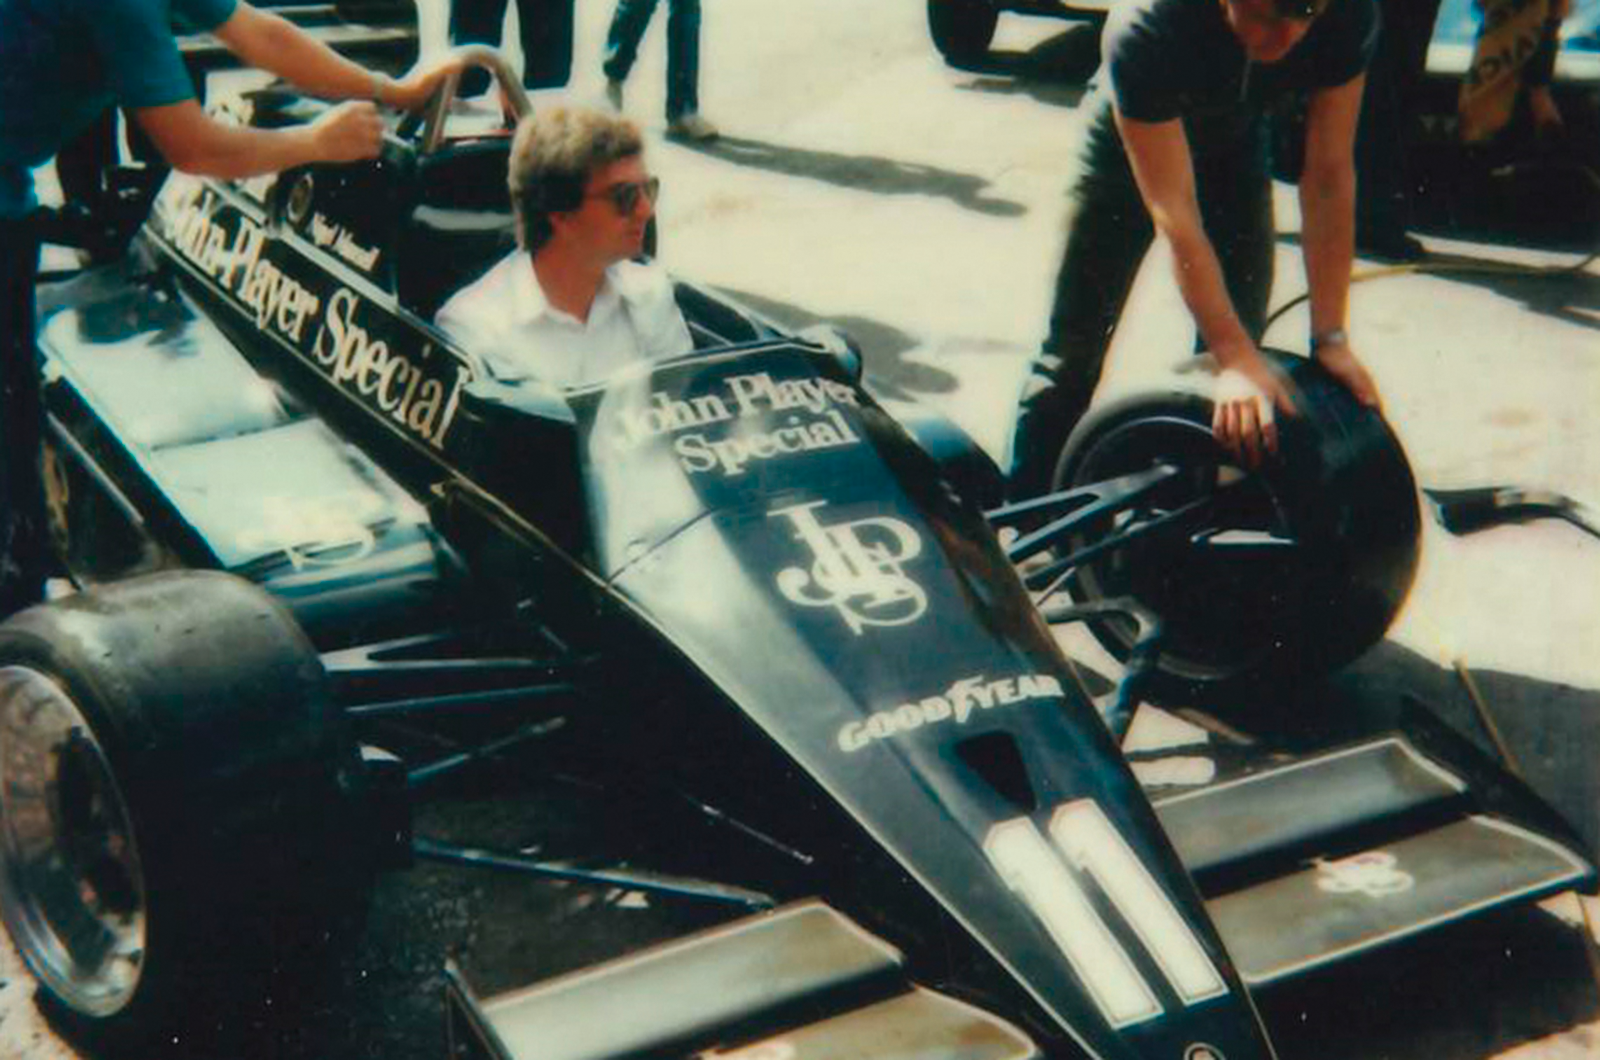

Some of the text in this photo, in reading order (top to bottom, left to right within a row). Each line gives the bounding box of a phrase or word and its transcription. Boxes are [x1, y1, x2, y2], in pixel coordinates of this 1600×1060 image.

[219, 215, 318, 342] Player
[311, 286, 471, 451] Special
[723, 371, 861, 415] Player
[674, 410, 861, 477] Special
[983, 797, 1230, 1031] 11
